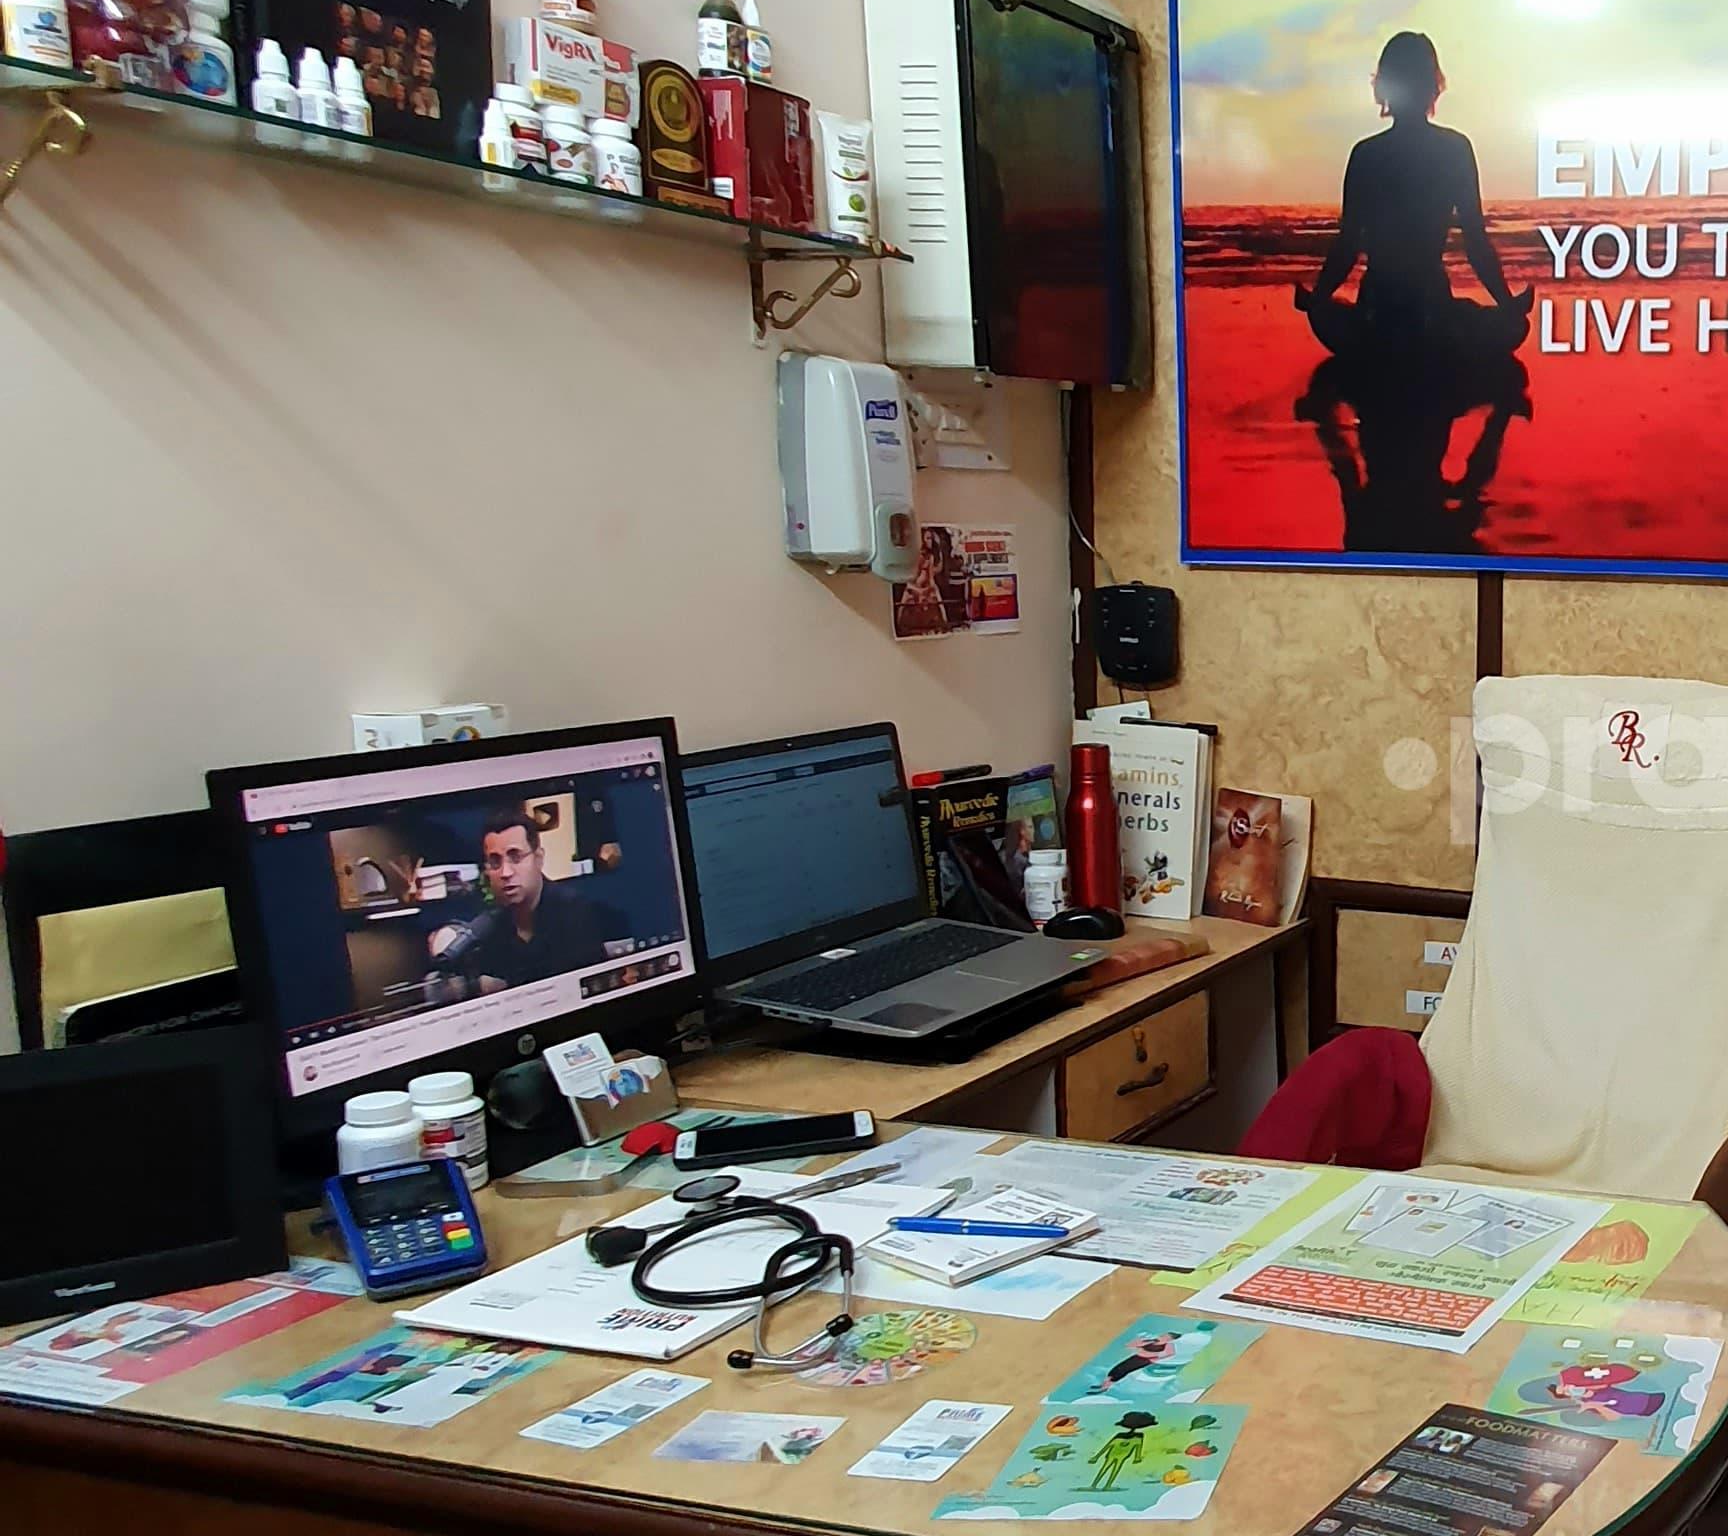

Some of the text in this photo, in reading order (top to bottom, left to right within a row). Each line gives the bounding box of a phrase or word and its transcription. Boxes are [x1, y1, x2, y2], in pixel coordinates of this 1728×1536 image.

[1539, 222, 1679, 279] YOU
[1538, 298, 1671, 355] LIVE
[1117, 766, 1184, 790] amins,
[1117, 790, 1181, 810] nerals
